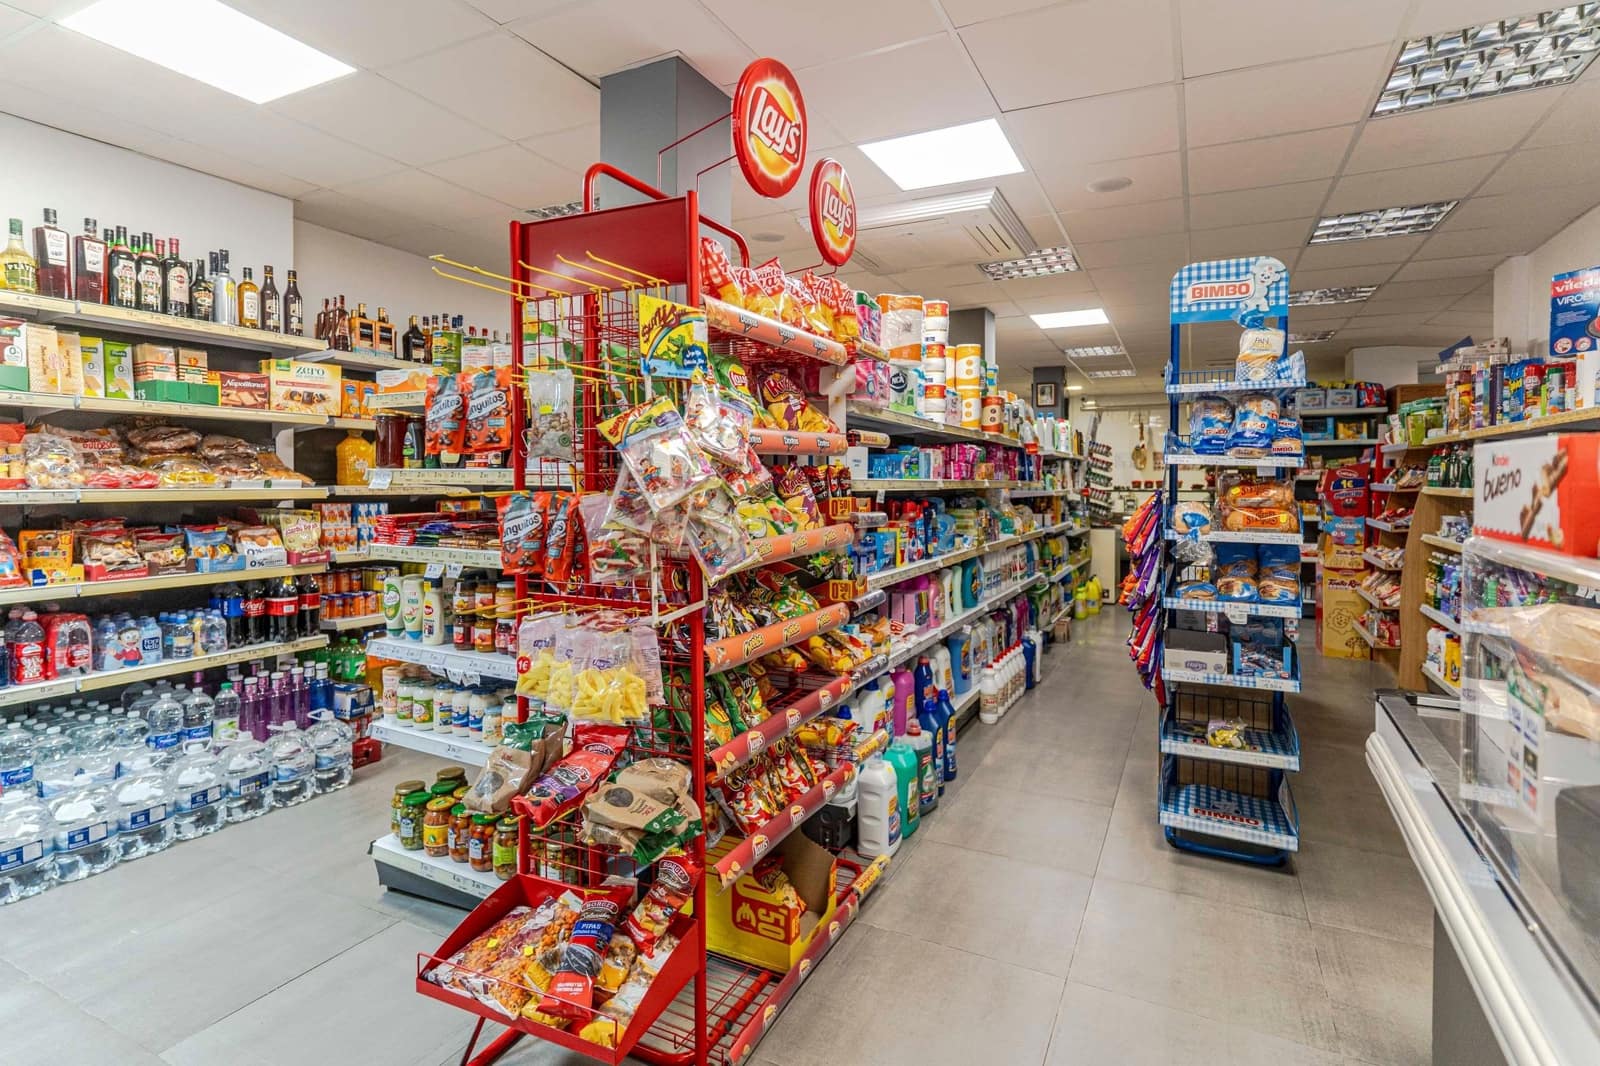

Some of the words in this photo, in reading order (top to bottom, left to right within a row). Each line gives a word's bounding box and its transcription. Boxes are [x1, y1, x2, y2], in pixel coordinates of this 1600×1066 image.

[751, 90, 800, 155] Lay's
[823, 184, 852, 238] Lay's
[1191, 283, 1250, 300] BIMBO
[296, 366, 325, 377] zero
[1484, 468, 1521, 502] bueno
